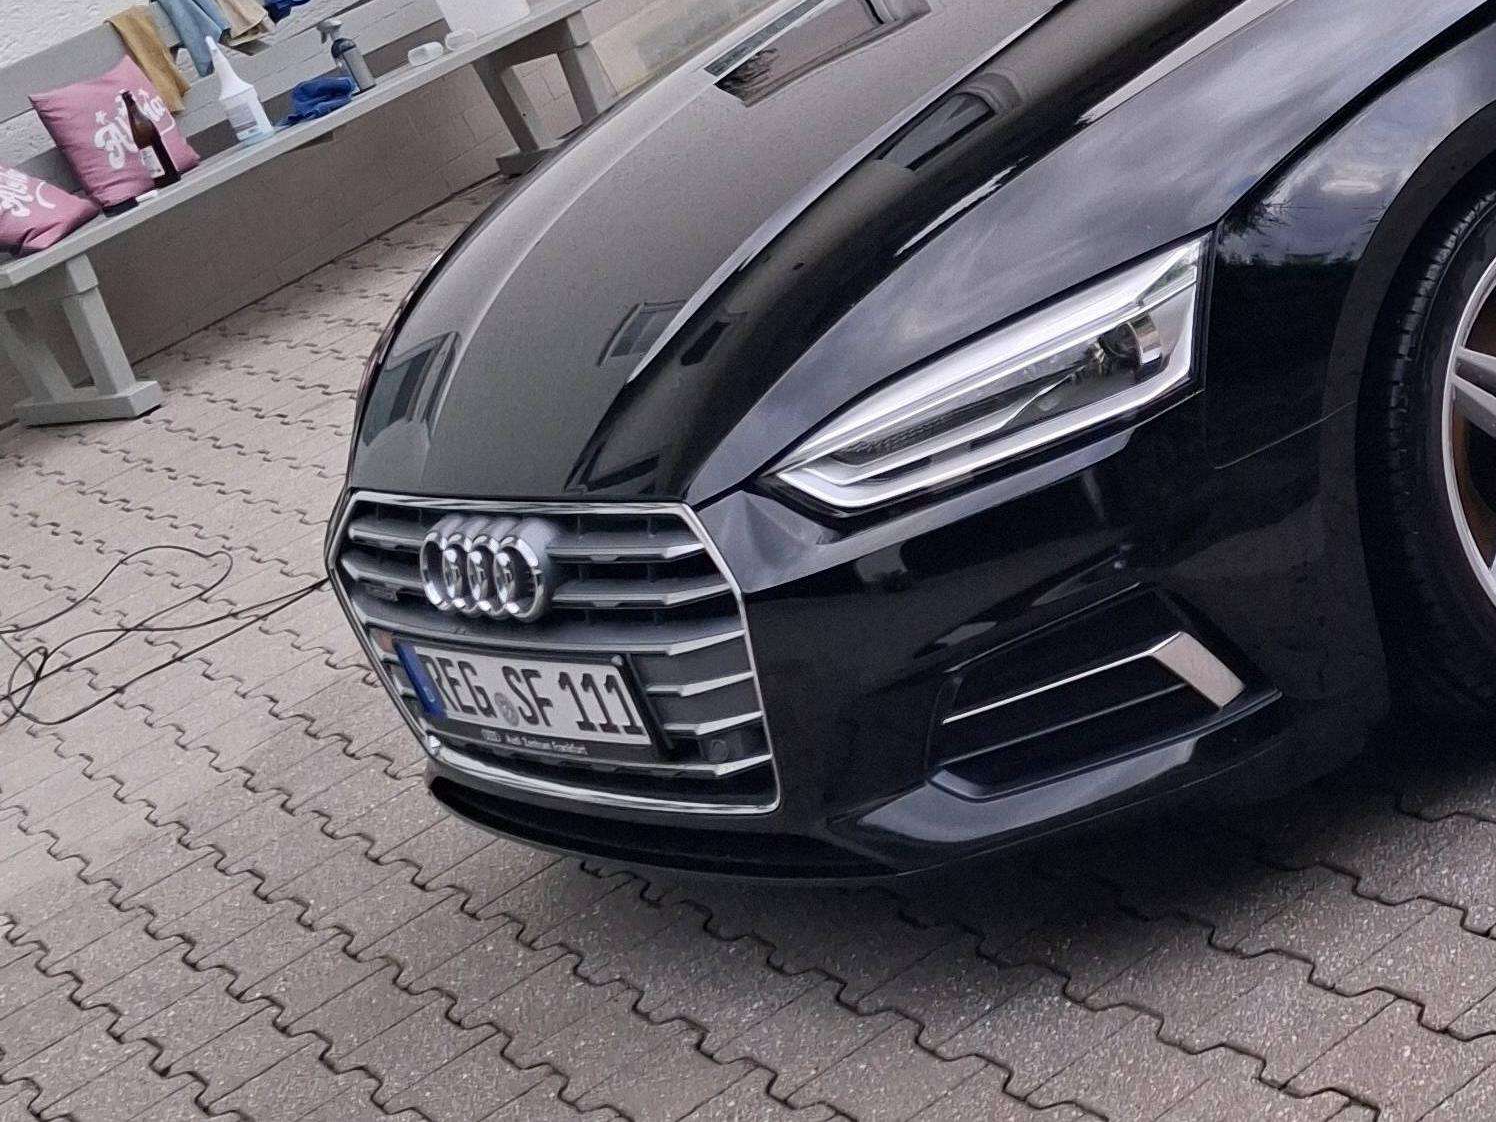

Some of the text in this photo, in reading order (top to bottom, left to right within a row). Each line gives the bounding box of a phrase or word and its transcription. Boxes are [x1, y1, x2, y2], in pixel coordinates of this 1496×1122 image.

[417, 654, 646, 736] REG SF 111
